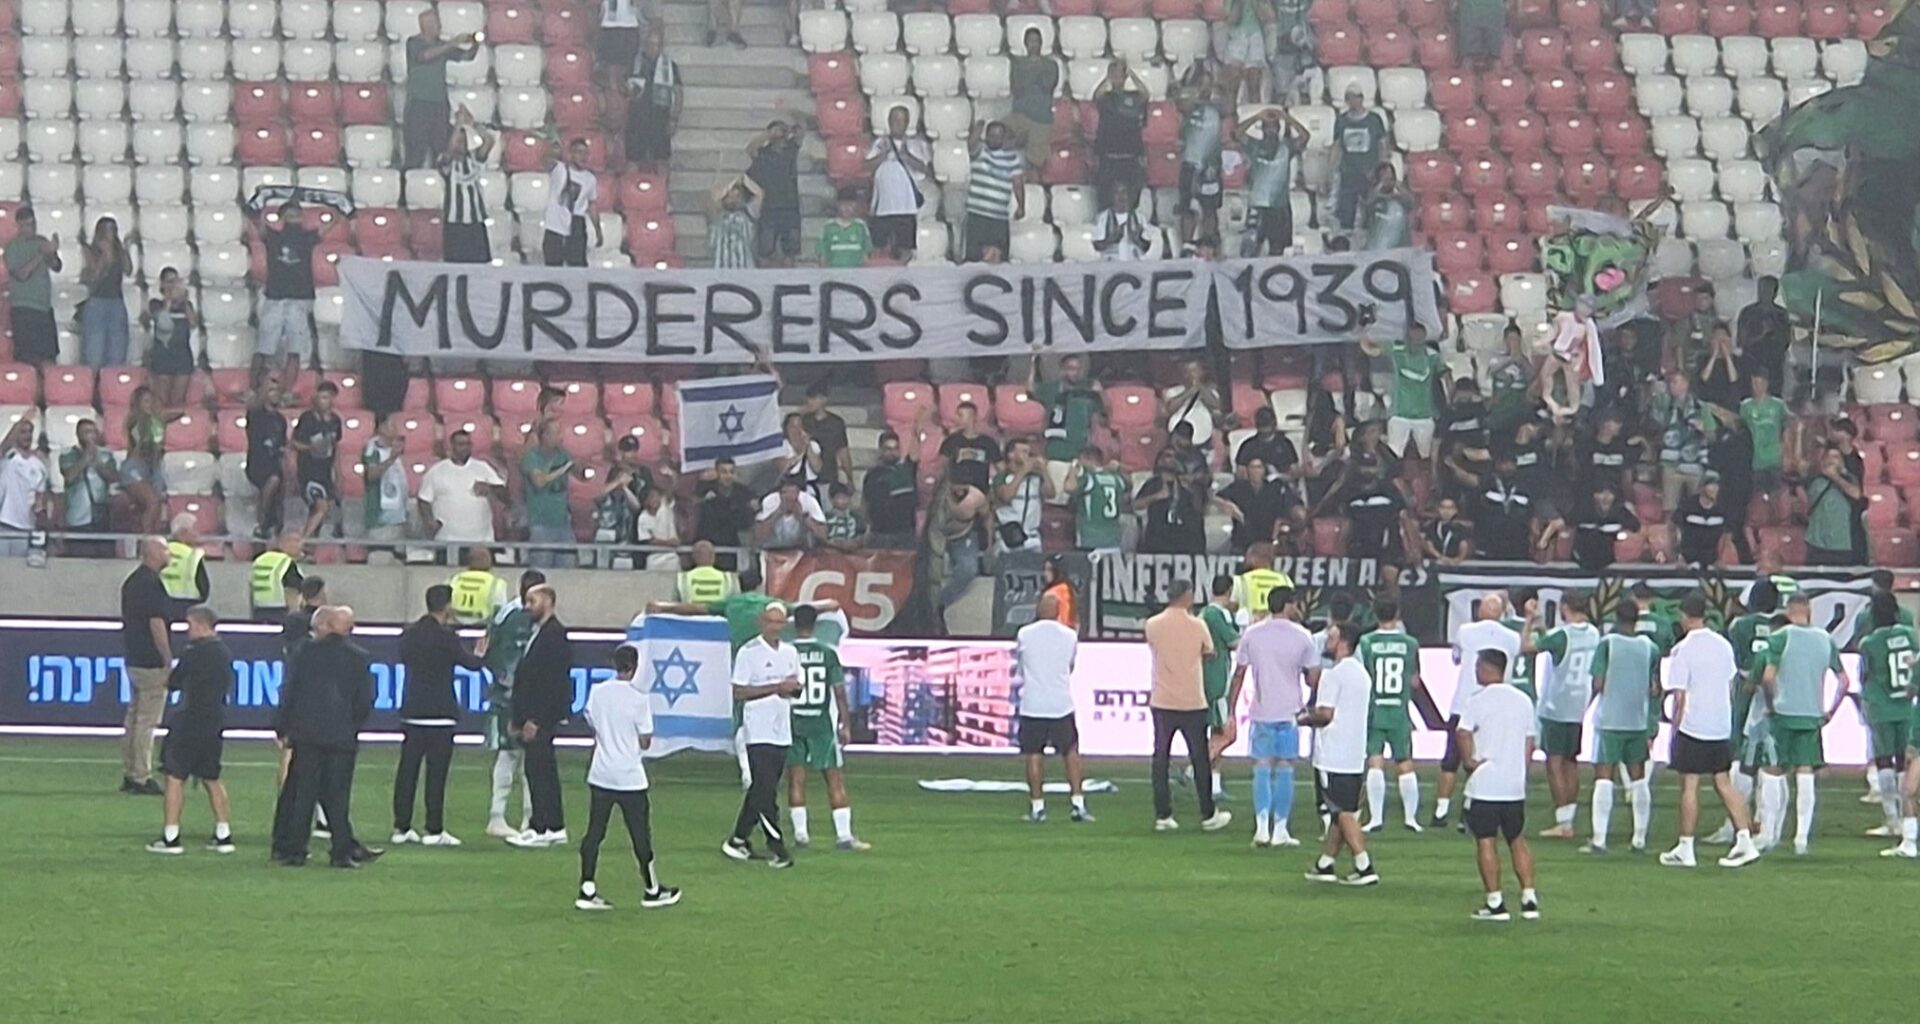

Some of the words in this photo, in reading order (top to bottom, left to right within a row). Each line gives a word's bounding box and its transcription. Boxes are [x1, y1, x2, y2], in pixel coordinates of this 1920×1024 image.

[375, 270, 922, 356] MURDERERS
[963, 270, 1194, 346] SINCE
[1237, 260, 1412, 340] 1939
[1103, 486, 1117, 518] 3
[1274, 556, 1348, 586] REEN
[1357, 557, 1428, 586] AES
[1375, 657, 1404, 694] 18
[1888, 650, 1913, 688] 15
